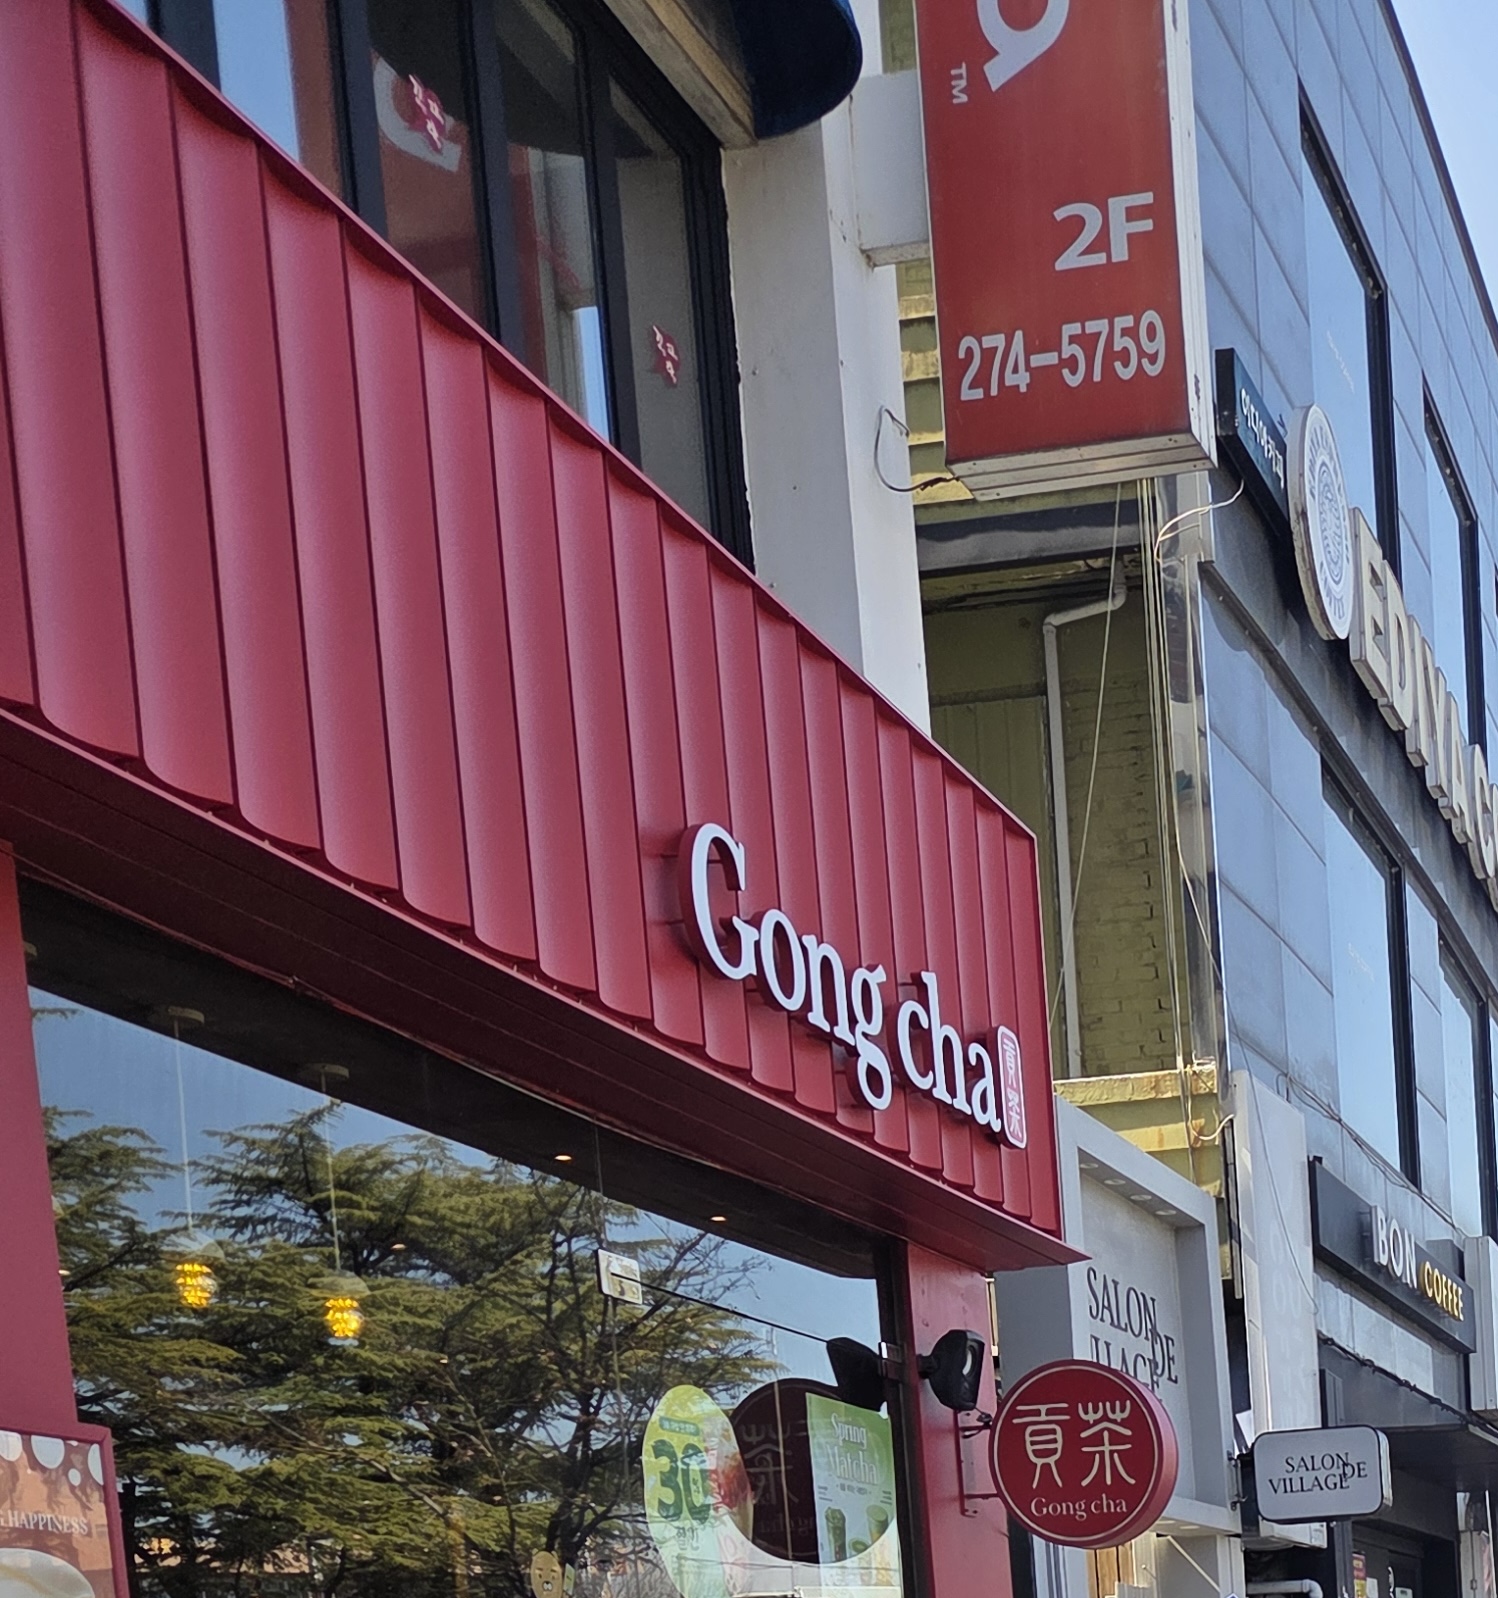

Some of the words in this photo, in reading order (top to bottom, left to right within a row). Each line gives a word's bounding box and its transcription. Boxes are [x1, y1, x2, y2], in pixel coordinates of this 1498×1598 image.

[1054, 192, 1154, 271] 2F
[957, 310, 1166, 402] 274-5759
[690, 822, 893, 1110] Gong
[897, 970, 1001, 1133] cha
[1373, 1204, 1418, 1289] BON
[1422, 1260, 1464, 1322] COFFEE
[1087, 1266, 1157, 1342] SALON
[1149, 1327, 1179, 1385] DE
[830, 1411, 868, 1450] Spring
[1012, 1399, 1136, 1489] 貢茶
[1285, 1451, 1349, 1474] SALON
[1342, 1461, 1368, 1480] DE
[7, 1509, 89, 1536] HAPPINESS
[1030, 1497, 1087, 1522] Gong
[1090, 1493, 1127, 1514] cha
[1268, 1472, 1350, 1495] VILLAGE
